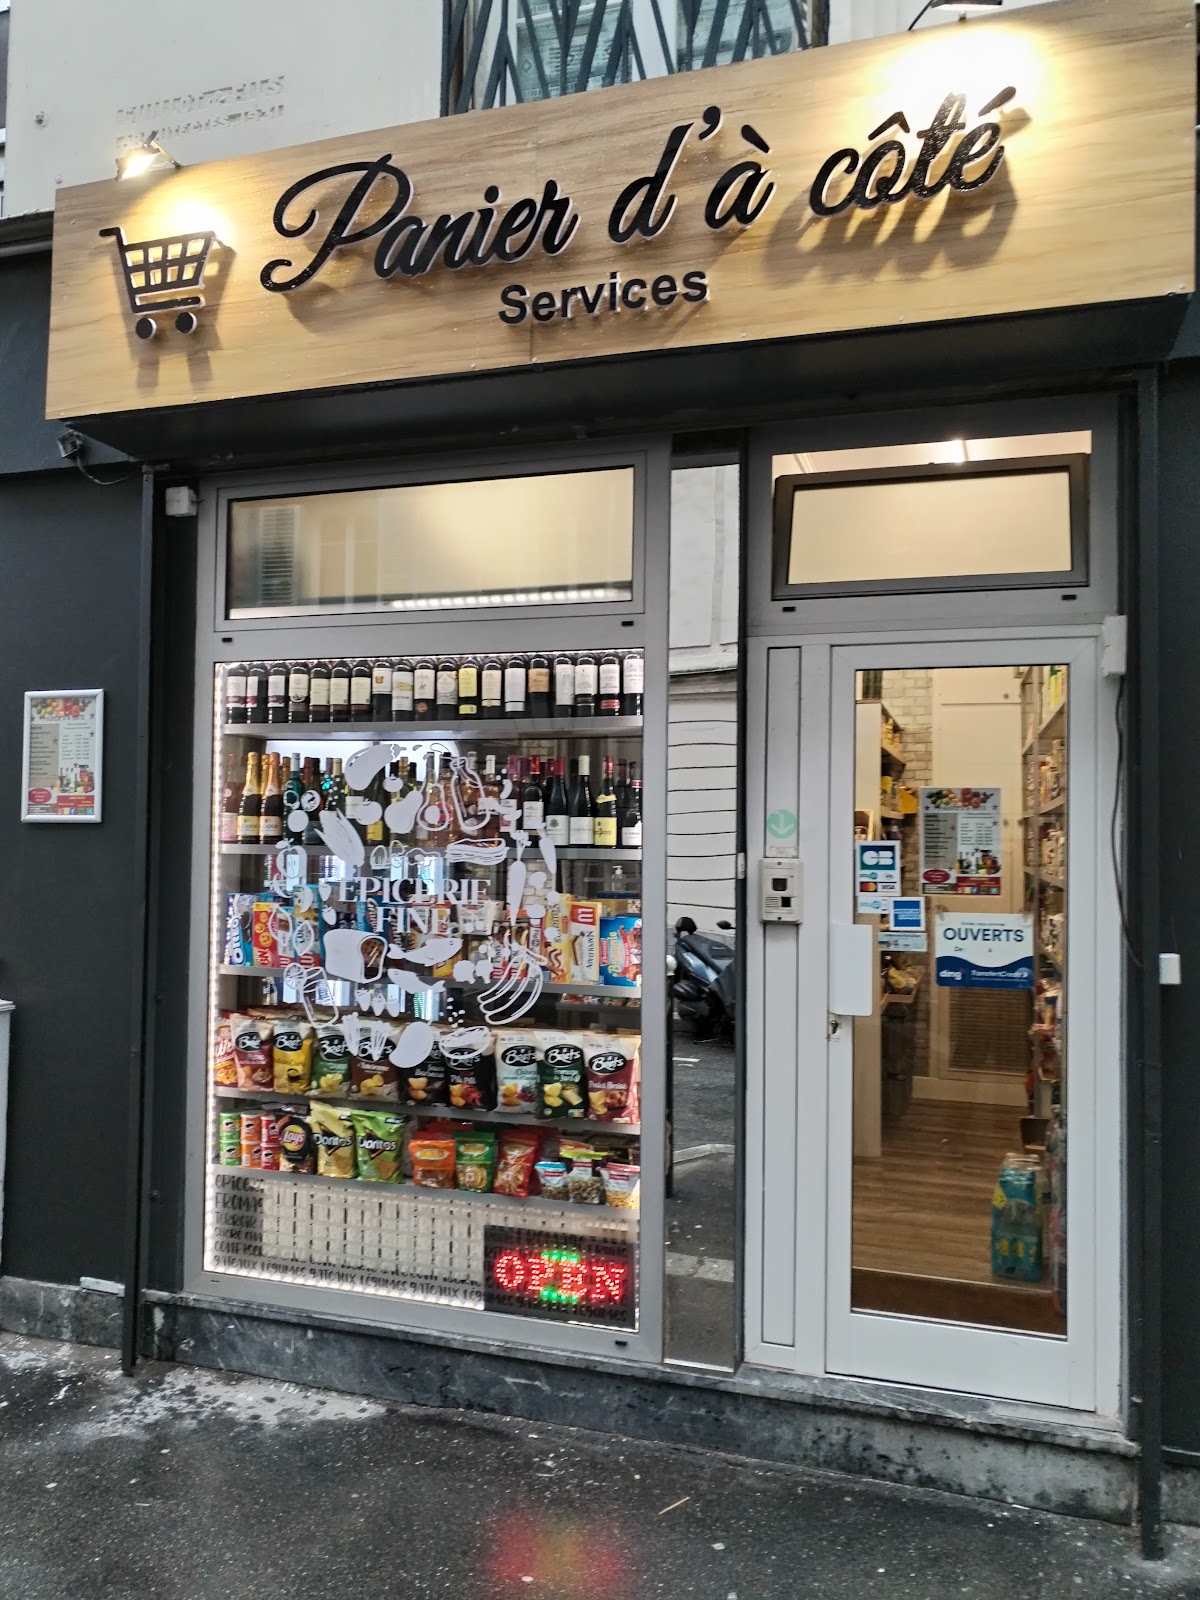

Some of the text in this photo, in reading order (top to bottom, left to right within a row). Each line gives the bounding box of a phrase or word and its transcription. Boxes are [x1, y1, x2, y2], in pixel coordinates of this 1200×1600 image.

[260, 85, 1018, 293] Panier d'à côté
[499, 270, 710, 325] Services
[376, 906, 452, 935] FINE
[577, 908, 594, 923] LU
[231, 917, 245, 966] OREO
[943, 927, 1025, 942] OUVERTS
[313, 1133, 352, 1147] Doritos
[357, 1136, 397, 1151] Doritos
[495, 1254, 626, 1301] OPEN
